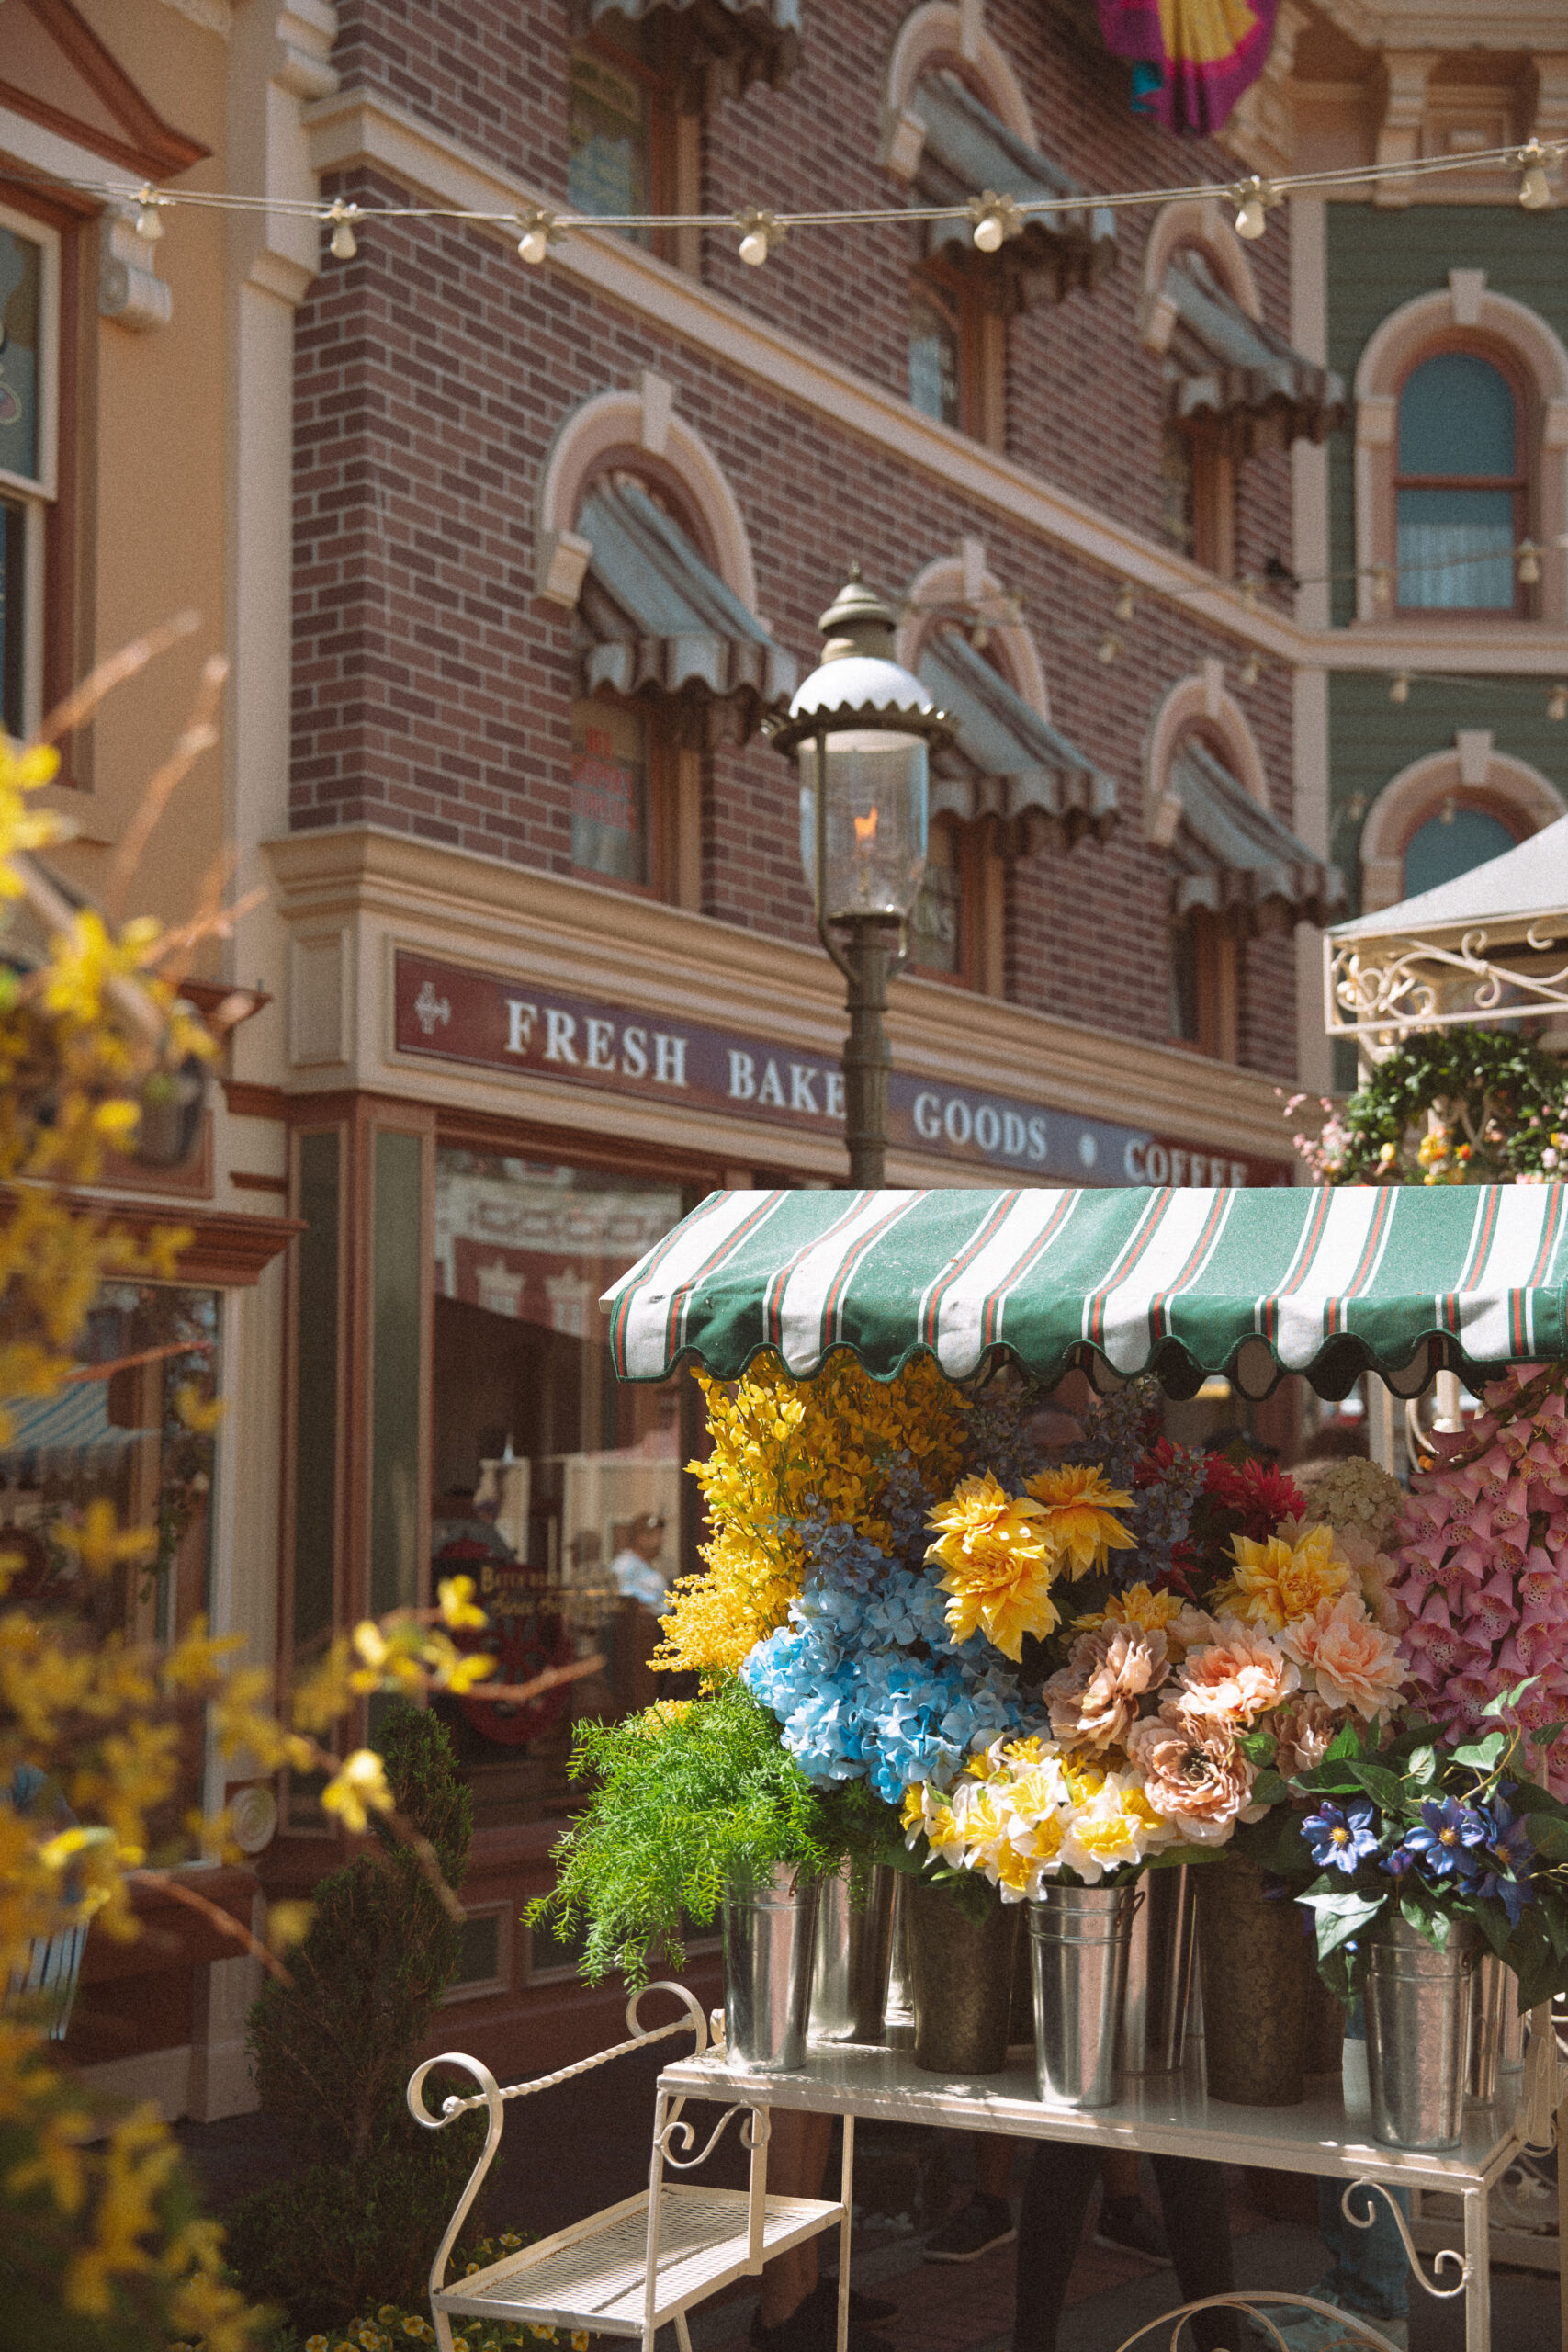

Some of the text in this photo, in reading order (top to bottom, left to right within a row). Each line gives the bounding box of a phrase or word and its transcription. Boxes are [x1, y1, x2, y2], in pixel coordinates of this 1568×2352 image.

[504, 1000, 688, 1088] FRESH
[728, 1048, 847, 1120] BAKE
[913, 1091, 1048, 1162] GOODS
